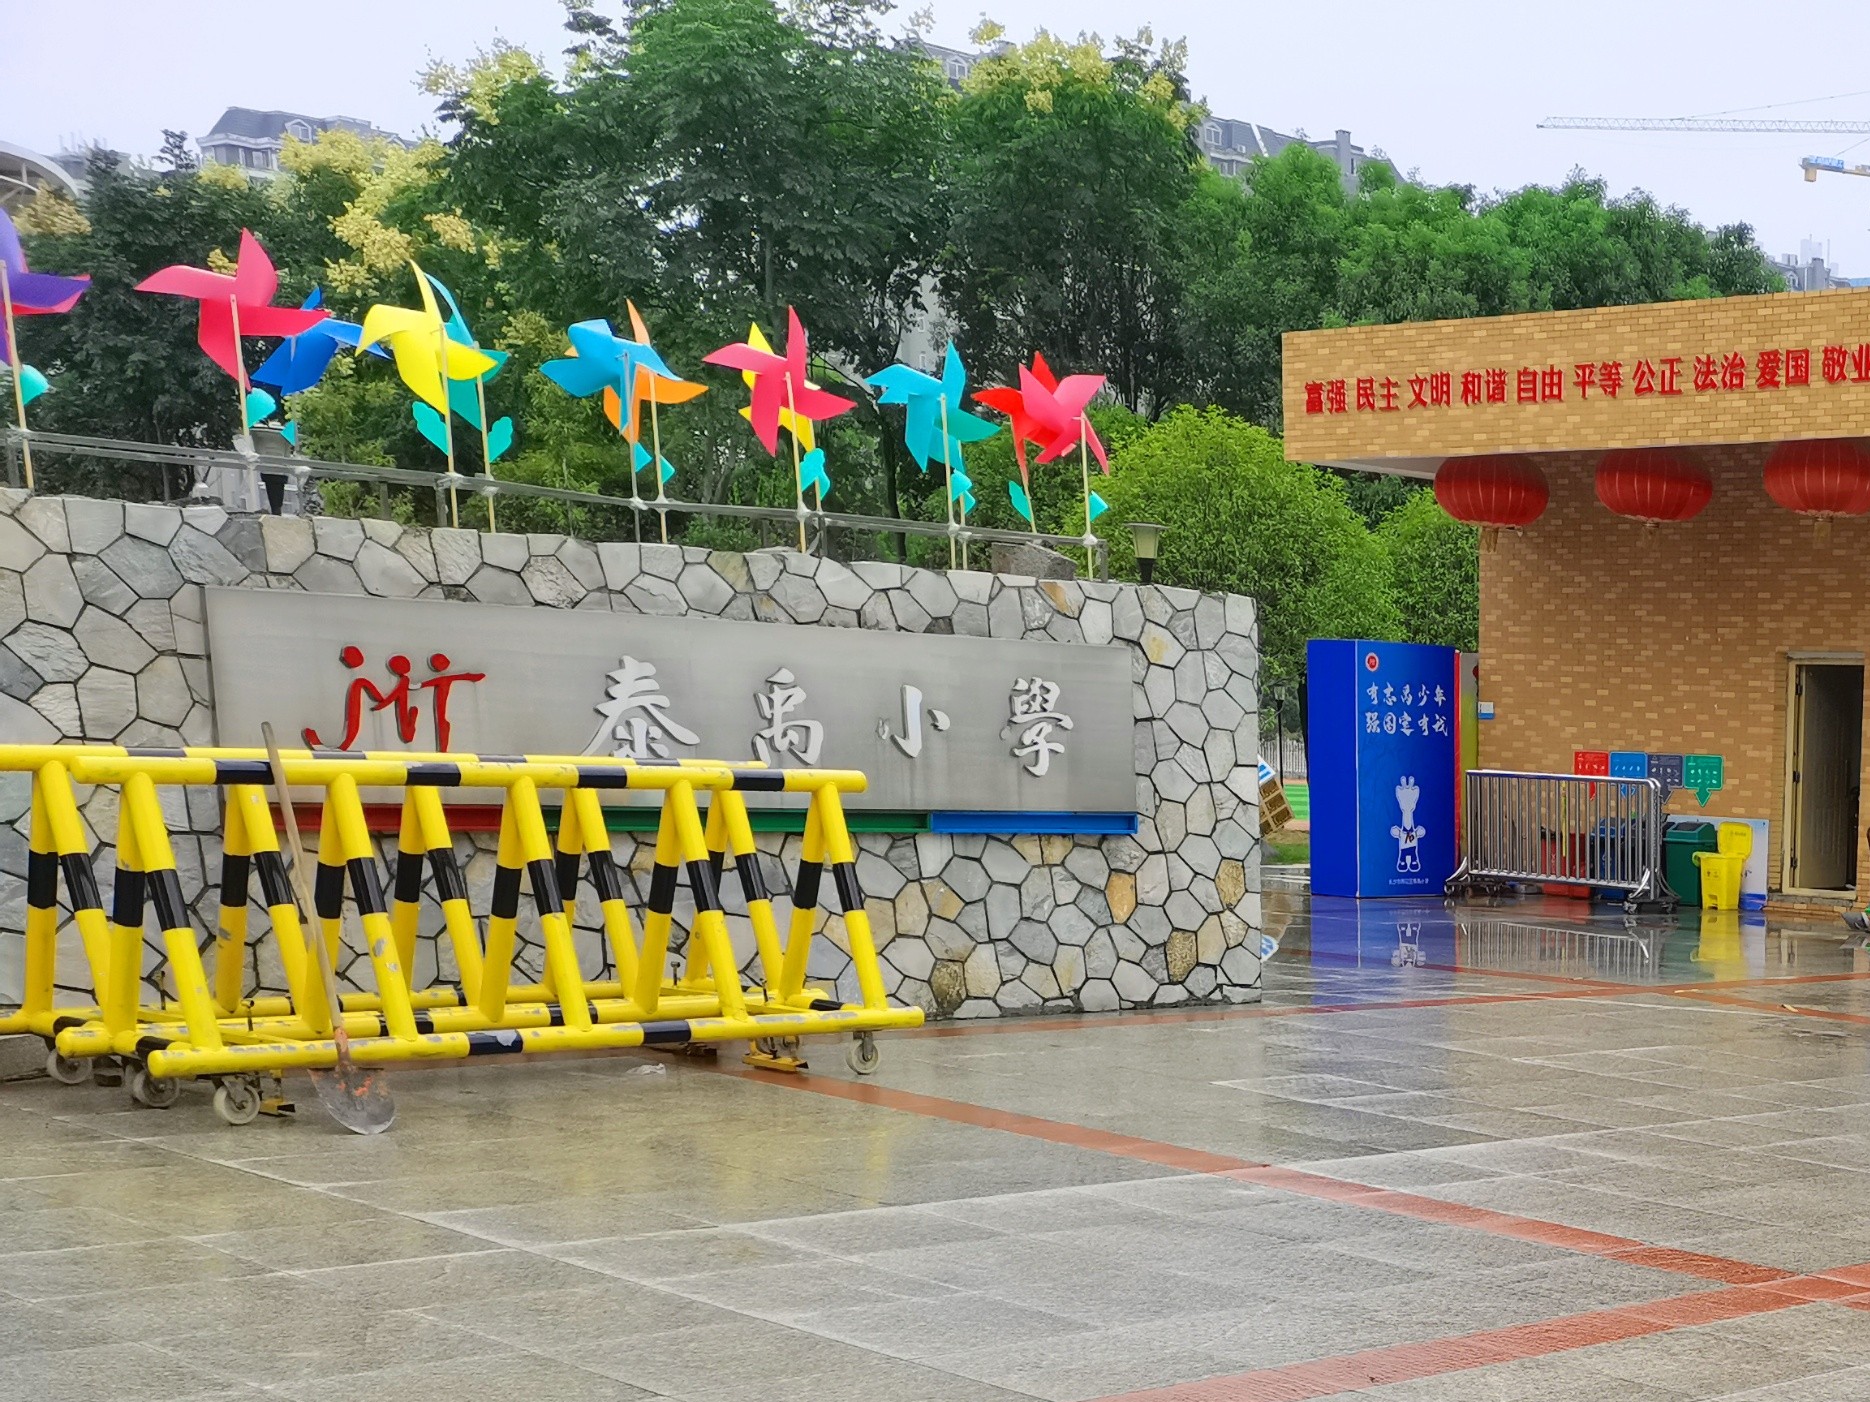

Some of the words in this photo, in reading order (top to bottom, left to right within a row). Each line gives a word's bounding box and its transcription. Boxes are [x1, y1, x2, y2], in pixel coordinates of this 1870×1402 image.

[1304, 379, 1347, 414] 富强
[1356, 376, 1399, 411] 民主
[1407, 372, 1451, 409] 文明
[1460, 369, 1507, 406] 和谐
[1517, 366, 1563, 403] 自由
[1574, 361, 1623, 399] 平等
[1632, 357, 1682, 396] 公正
[1693, 352, 1746, 392] 法治
[1756, 348, 1810, 390] 爱国
